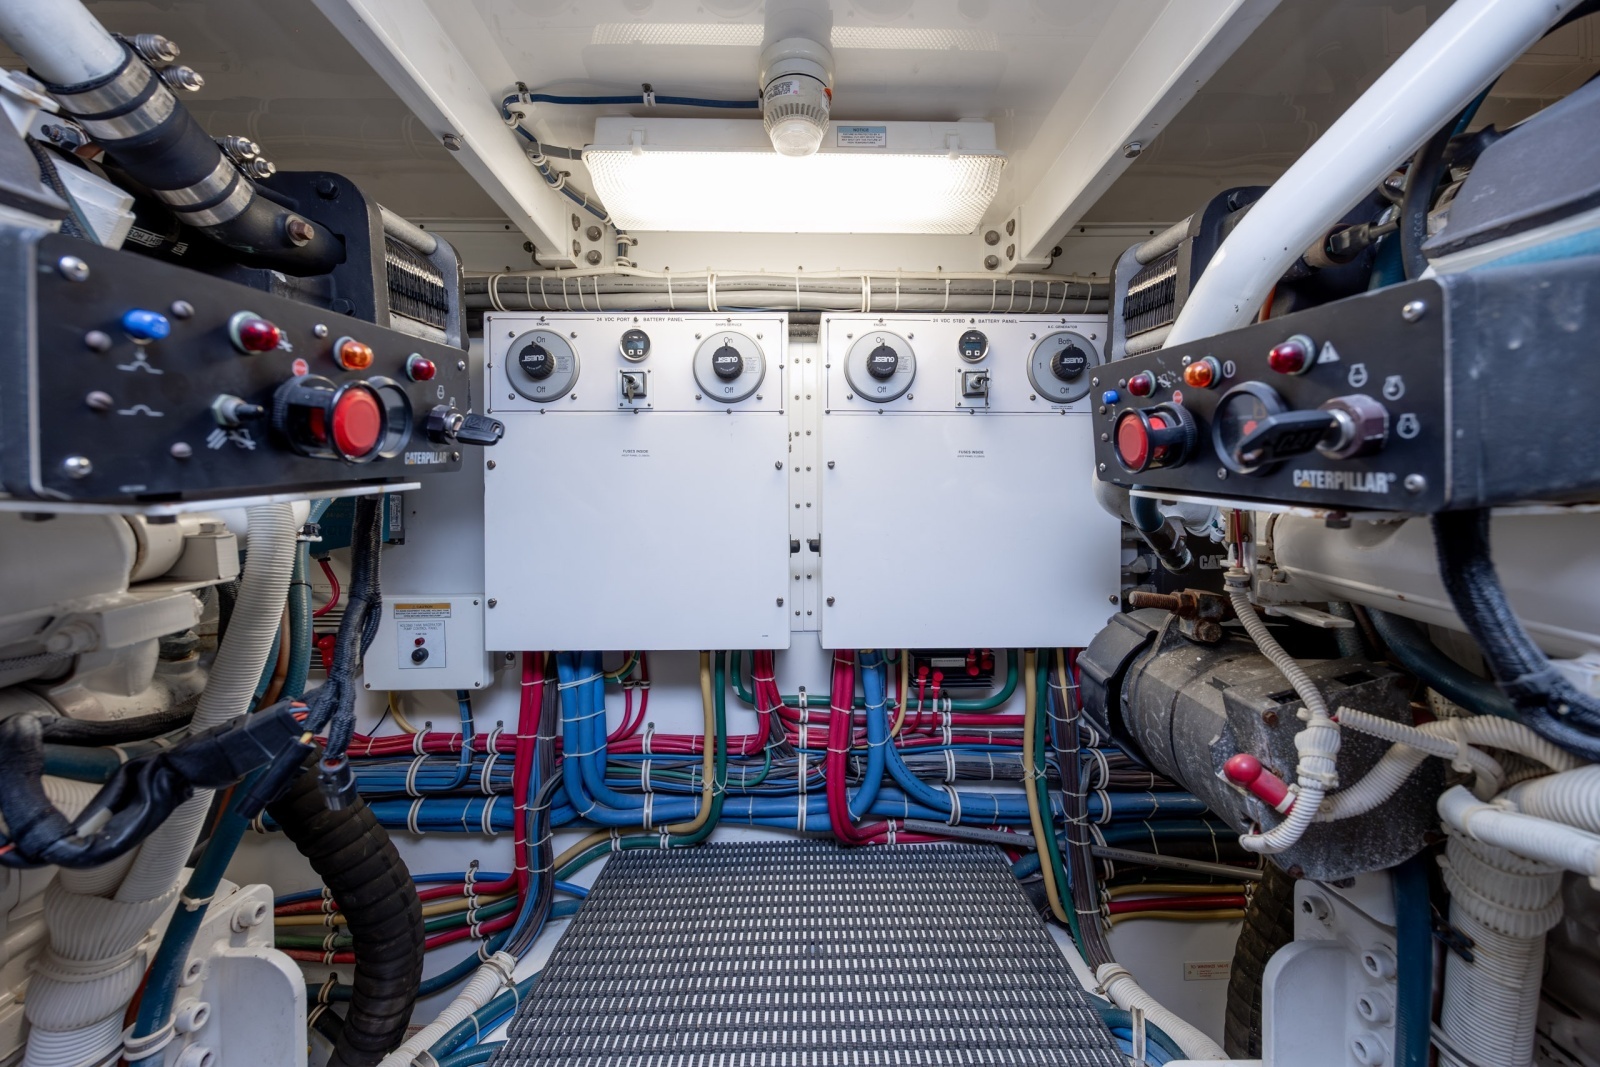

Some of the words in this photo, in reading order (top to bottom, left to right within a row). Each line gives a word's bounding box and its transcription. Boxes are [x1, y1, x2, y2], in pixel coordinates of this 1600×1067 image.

[404, 452, 448, 465] CATERPILLAR
[1293, 469, 1389, 494] CATERPILLAR
[1200, 555, 1226, 569] CAT
